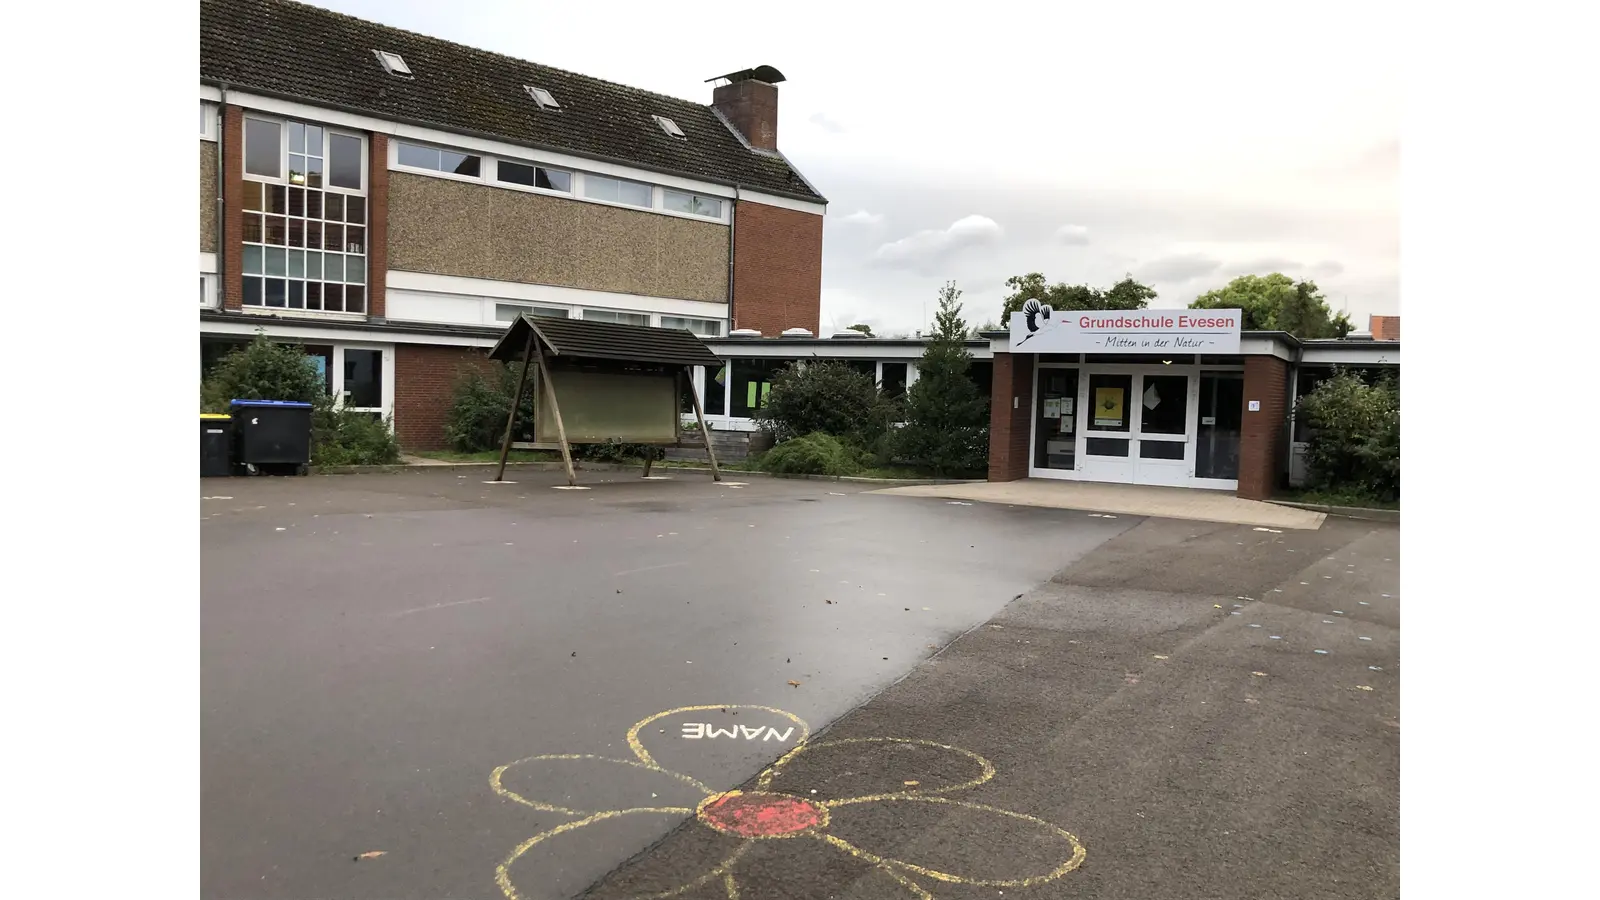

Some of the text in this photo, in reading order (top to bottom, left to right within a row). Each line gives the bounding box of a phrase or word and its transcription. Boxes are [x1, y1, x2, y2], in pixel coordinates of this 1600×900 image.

[1079, 315, 1234, 328] Grundschule Evesen
[1104, 336, 1137, 348] Mitten
[1141, 338, 1150, 348] in
[1154, 336, 1170, 348] der
[1173, 336, 1204, 348] Natur
[681, 722, 795, 742] NAME
